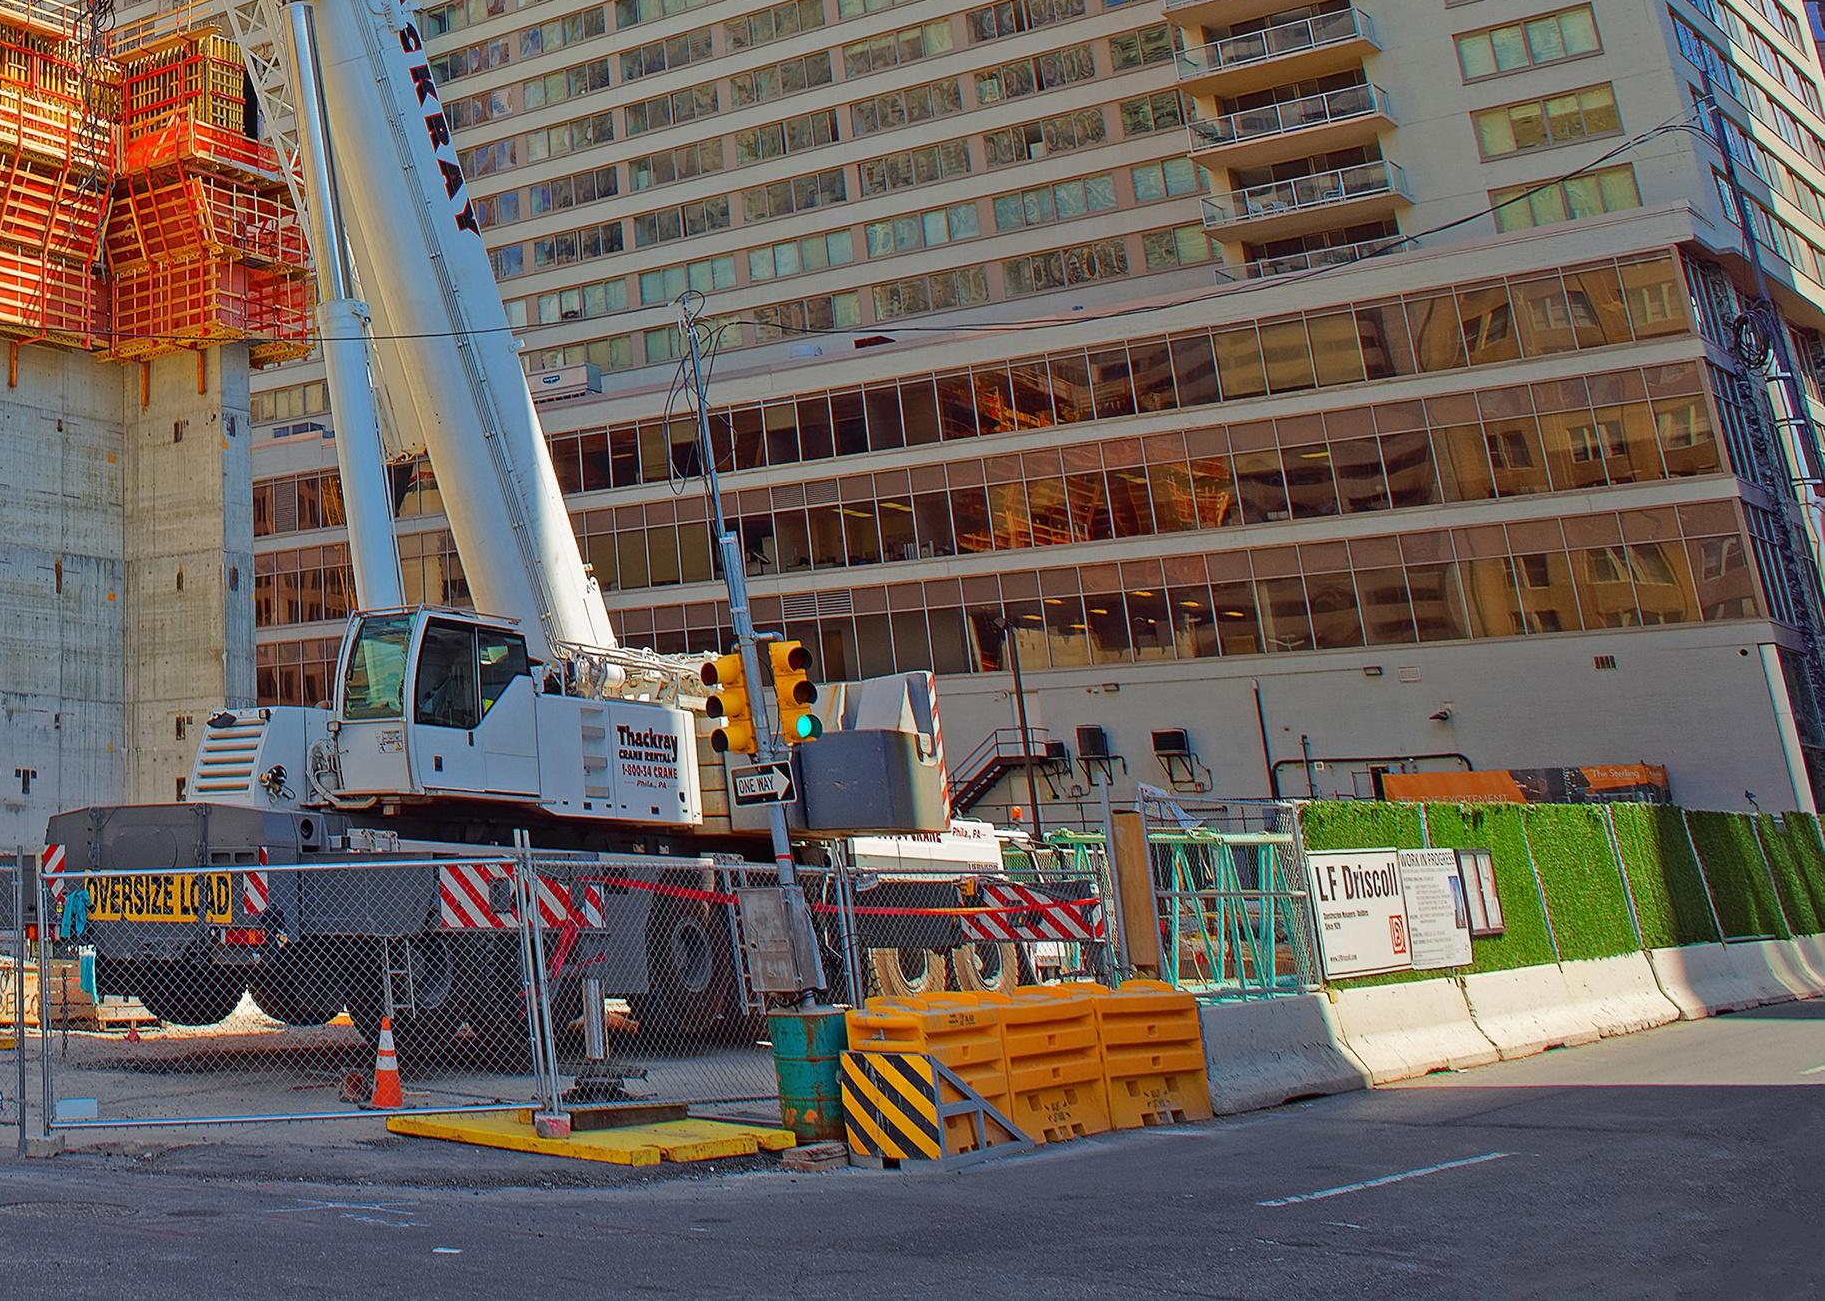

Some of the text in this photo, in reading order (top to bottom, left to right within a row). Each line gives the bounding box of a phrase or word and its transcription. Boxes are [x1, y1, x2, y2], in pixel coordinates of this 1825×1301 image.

[616, 724, 678, 763] Thackray
[618, 749, 671, 763] CRANE RENTAL
[622, 763, 678, 779] 1-800-34 CRANE
[738, 775, 775, 795] ONE WAY
[86, 873, 230, 916] OVERSIZE LOAD
[1341, 862, 1398, 900] Driscoll
